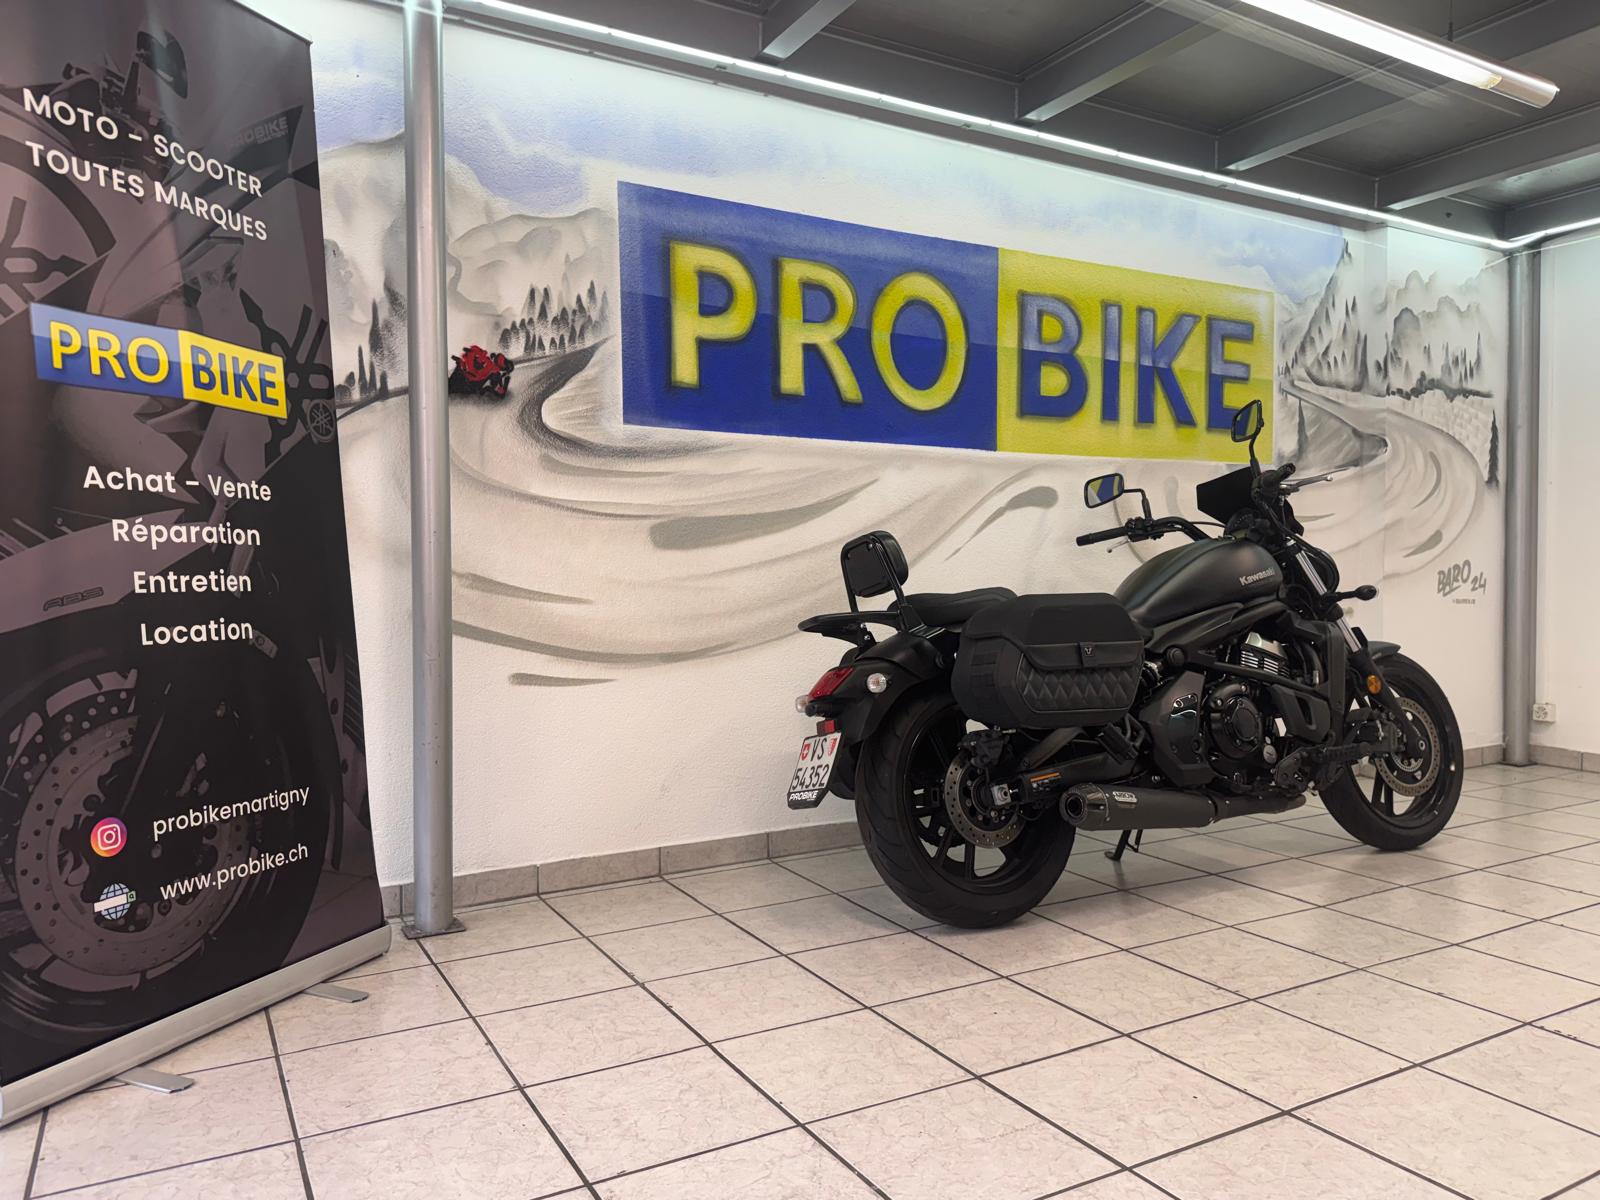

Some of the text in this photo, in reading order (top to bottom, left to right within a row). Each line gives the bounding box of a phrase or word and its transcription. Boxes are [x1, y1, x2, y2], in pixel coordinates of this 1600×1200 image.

[23, 88, 119, 141] MOTO
[154, 134, 263, 198] SCOOTER
[25, 140, 268, 241] TOUTES MARQUES
[669, 240, 1256, 432] PRO BIKE
[50, 321, 280, 406] PRO BIKE
[83, 465, 176, 493] Achat
[208, 474, 272, 501] Vente
[112, 517, 261, 550] Réparation
[133, 568, 252, 594] Entretien
[1470, 571, 1487, 595] 24
[141, 618, 253, 646] Location
[810, 738, 827, 761] VS
[792, 764, 829, 790] 54352
[789, 791, 818, 801] PROBIKE
[153, 787, 310, 841] probikemartigny
[160, 843, 309, 900] www.probike.ch
